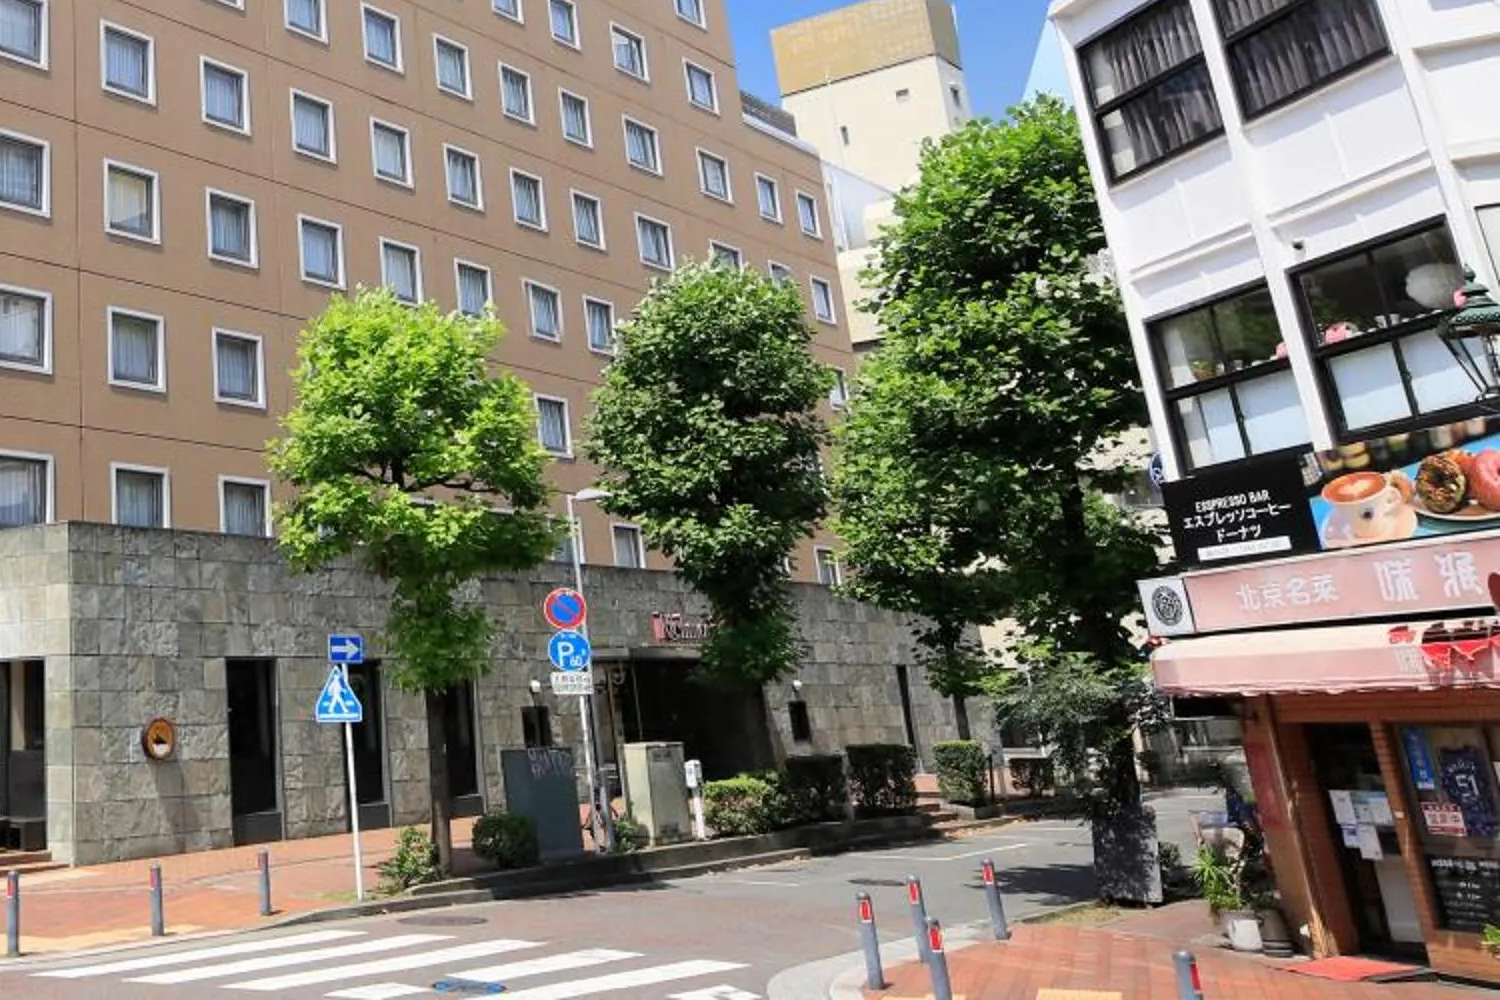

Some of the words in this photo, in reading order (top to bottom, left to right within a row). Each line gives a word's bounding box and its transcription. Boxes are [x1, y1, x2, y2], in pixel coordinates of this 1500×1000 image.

[1248, 489, 1271, 505] BAR
[1183, 503, 1292, 529] エスプレッソコーヒー
[1216, 524, 1262, 543] ドーナツ
[557, 641, 574, 667] P
[1455, 774, 1480, 797] 51
